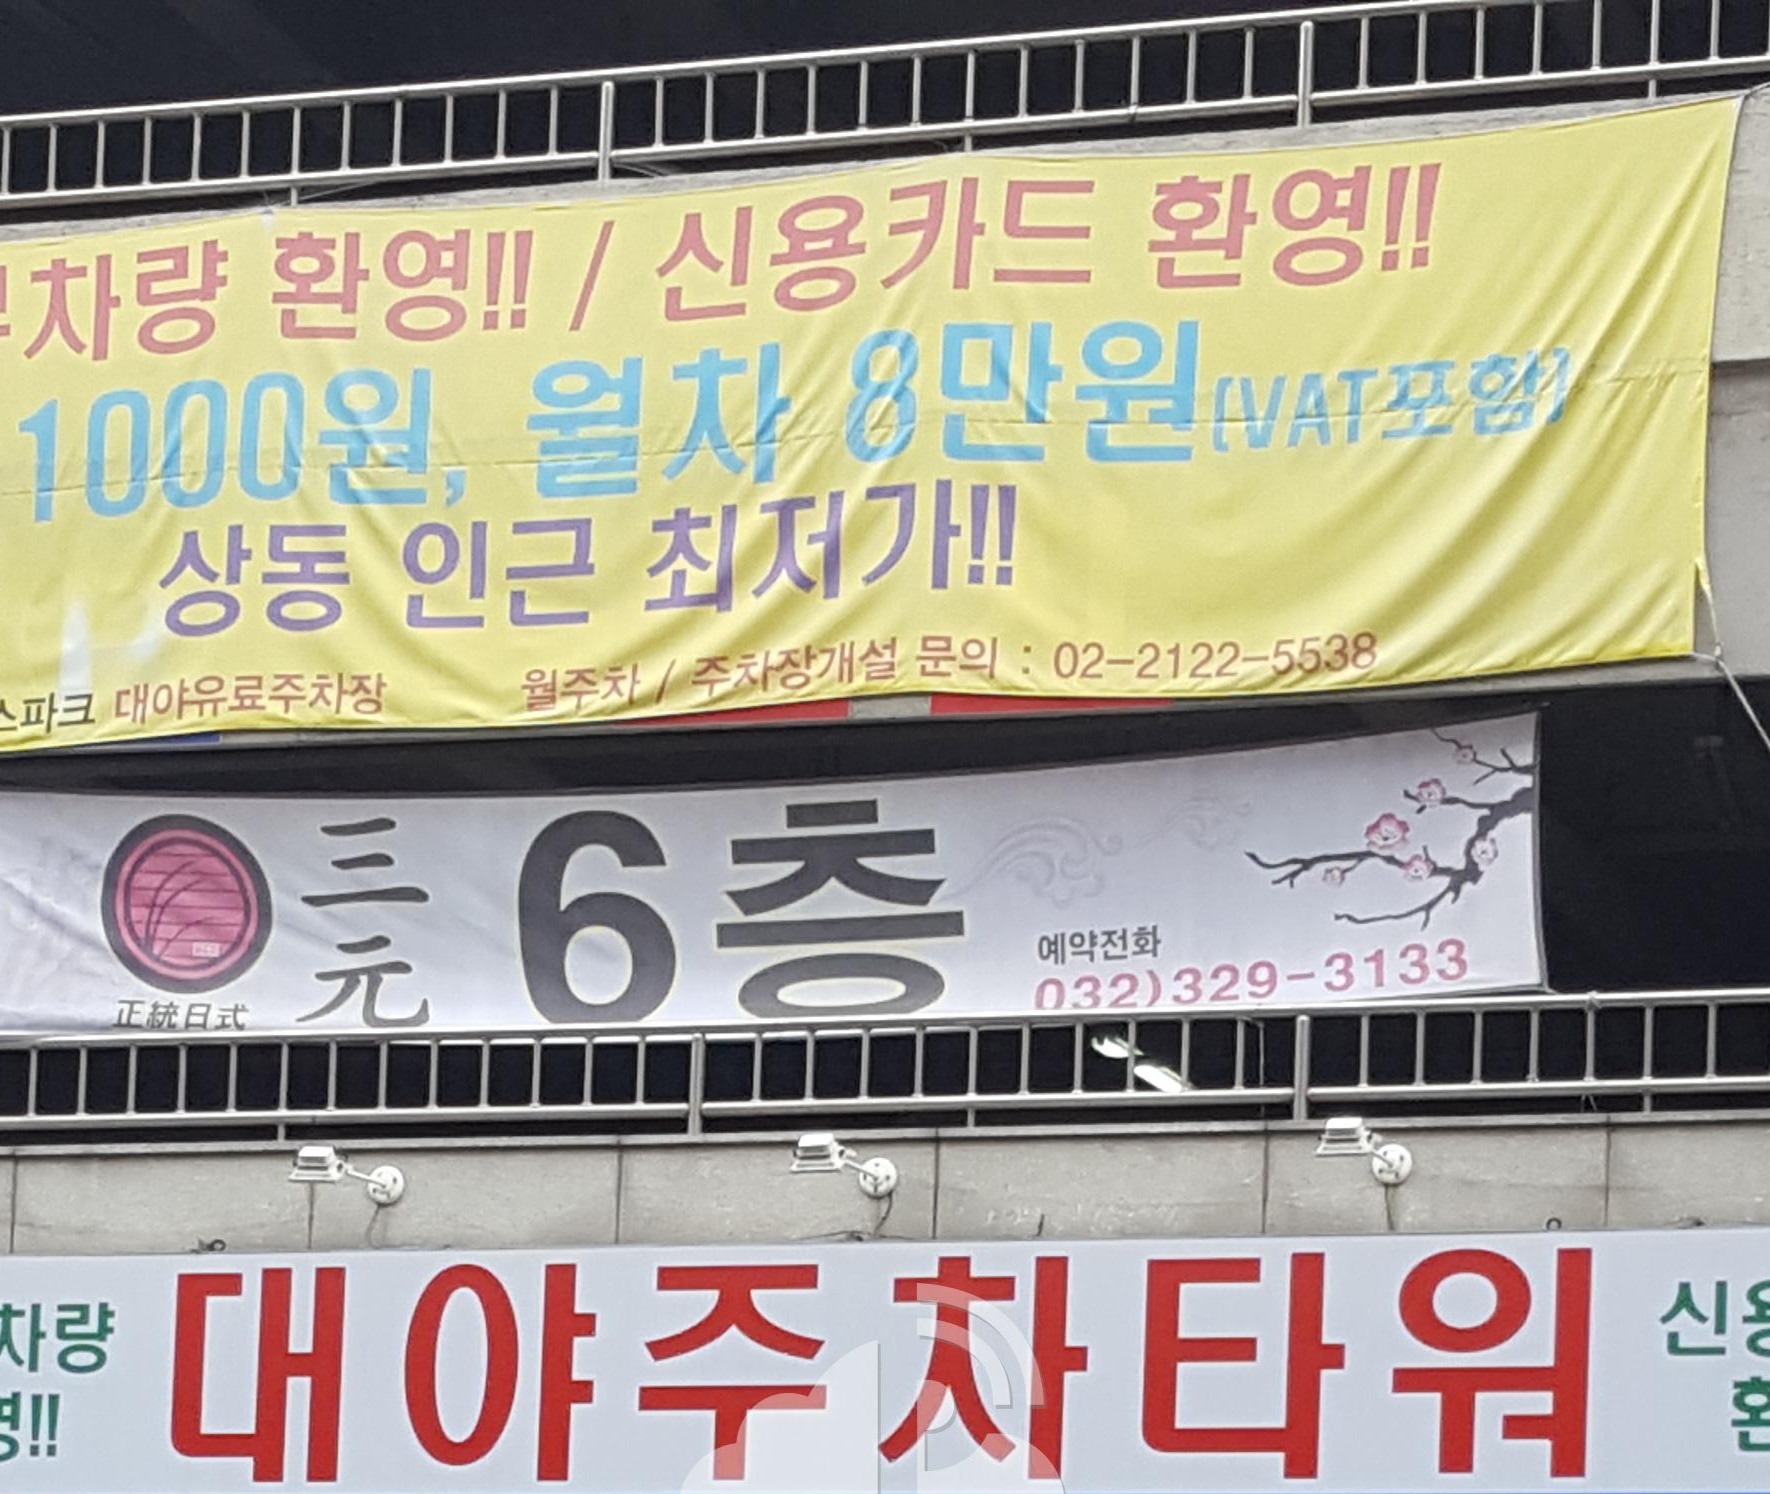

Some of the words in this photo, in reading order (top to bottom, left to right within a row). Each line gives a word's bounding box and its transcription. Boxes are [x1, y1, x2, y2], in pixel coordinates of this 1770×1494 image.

[273, 226, 535, 345] 환영!!
[654, 175, 1098, 325] 신용카드
[1146, 161, 1442, 290] 환영!!
[17, 366, 468, 525] 1000원,
[525, 341, 791, 501] 월차
[158, 522, 352, 639] 상동
[401, 516, 597, 630] 인근
[644, 475, 1018, 616] 최저가!!
[113, 671, 389, 726] 대야유료주차장
[521, 660, 642, 713] 월주차
[690, 638, 899, 698] 주차장개설
[915, 633, 1000, 682] 문의
[1053, 631, 1379, 683] 02-2122-5538
[513, 802, 968, 1024] 6층
[1034, 938, 1470, 1010] 032)329-3133
[1037, 926, 1161, 966] 예약전화
[113, 999, 249, 1030] 正統日式
[170, 1247, 1593, 1484] 대야주차타워
